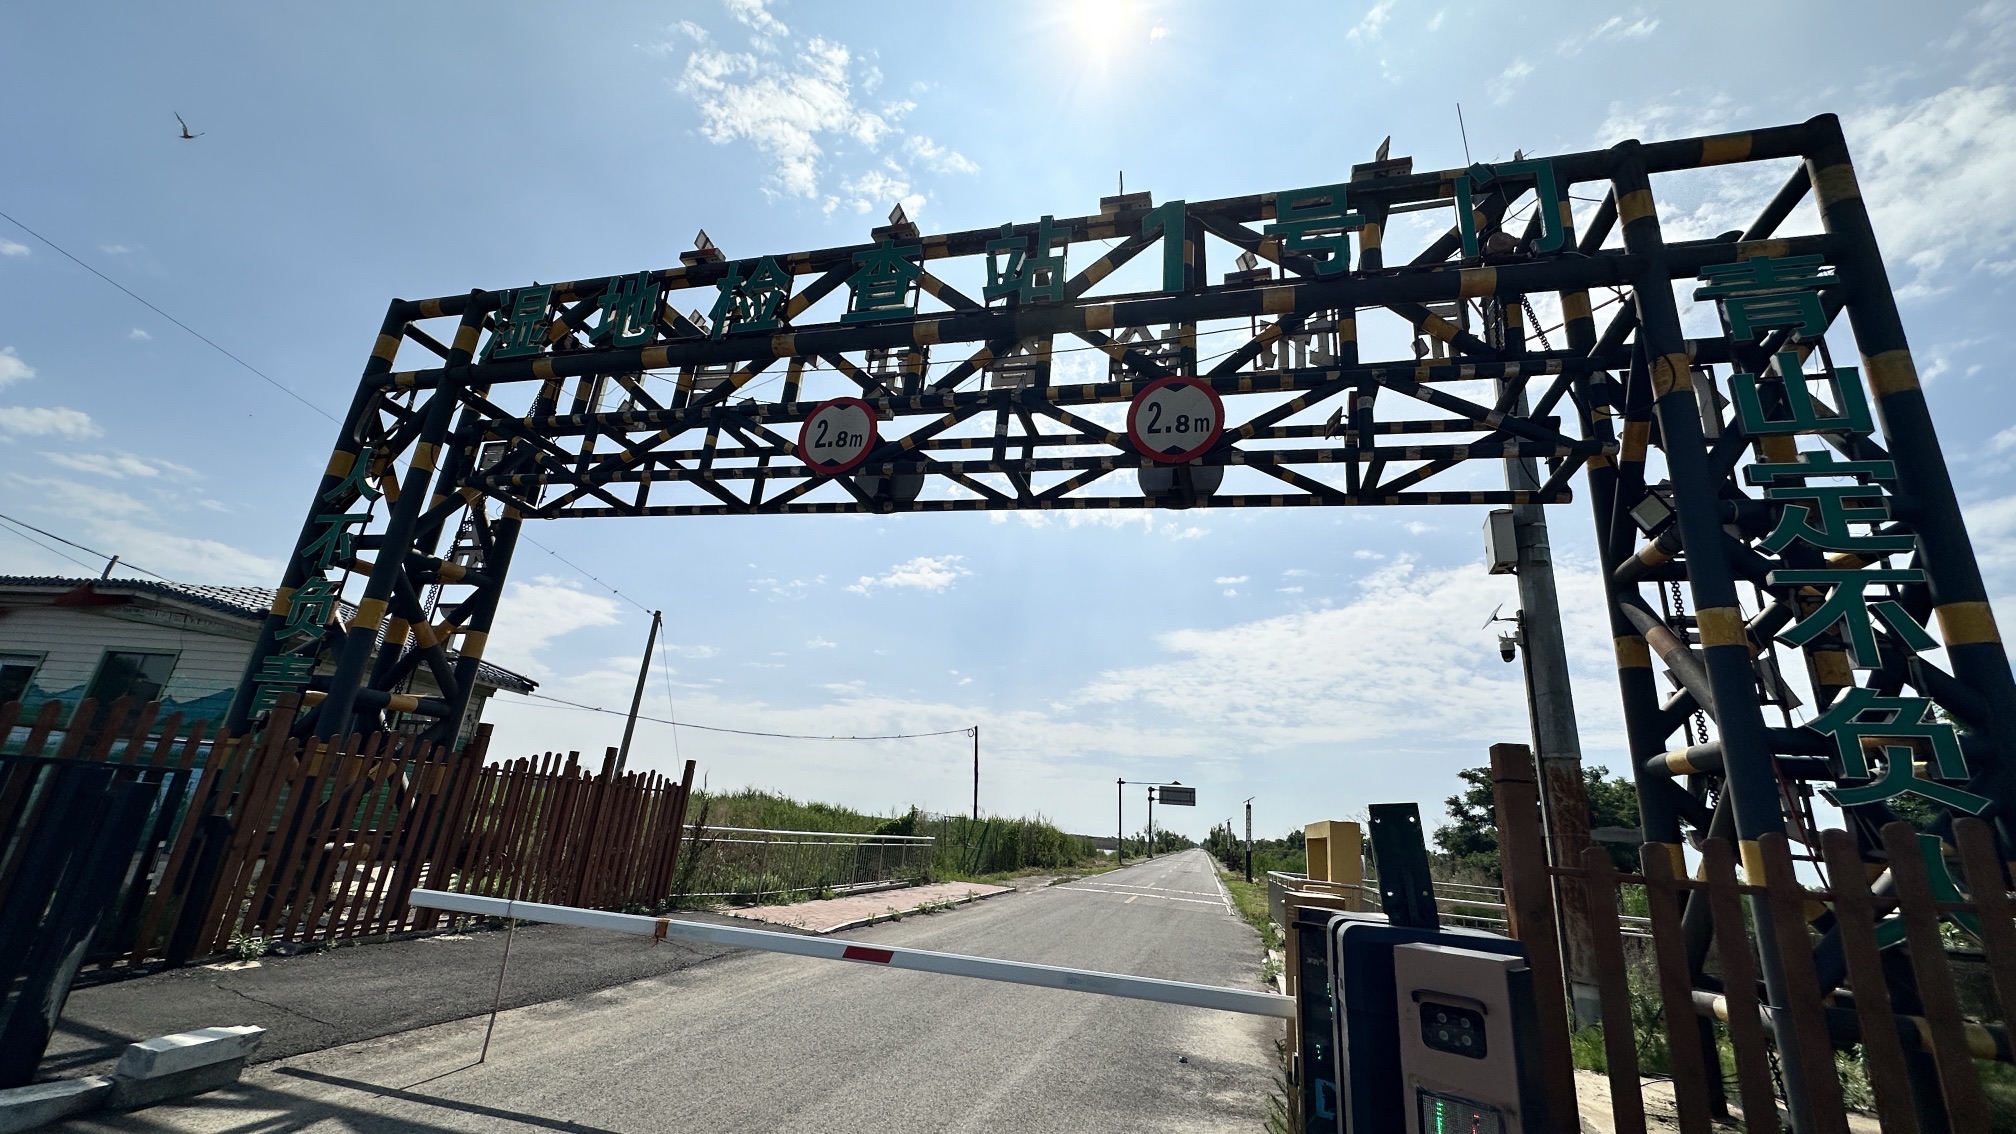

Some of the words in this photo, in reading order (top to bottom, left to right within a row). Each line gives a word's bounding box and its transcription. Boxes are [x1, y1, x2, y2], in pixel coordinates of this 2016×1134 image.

[480, 158, 1566, 360] 湿地检查站1号门
[814, 419, 863, 449] 2.8m
[1147, 401, 1211, 434] 2.8m
[216, 446, 384, 794] 人不负青
